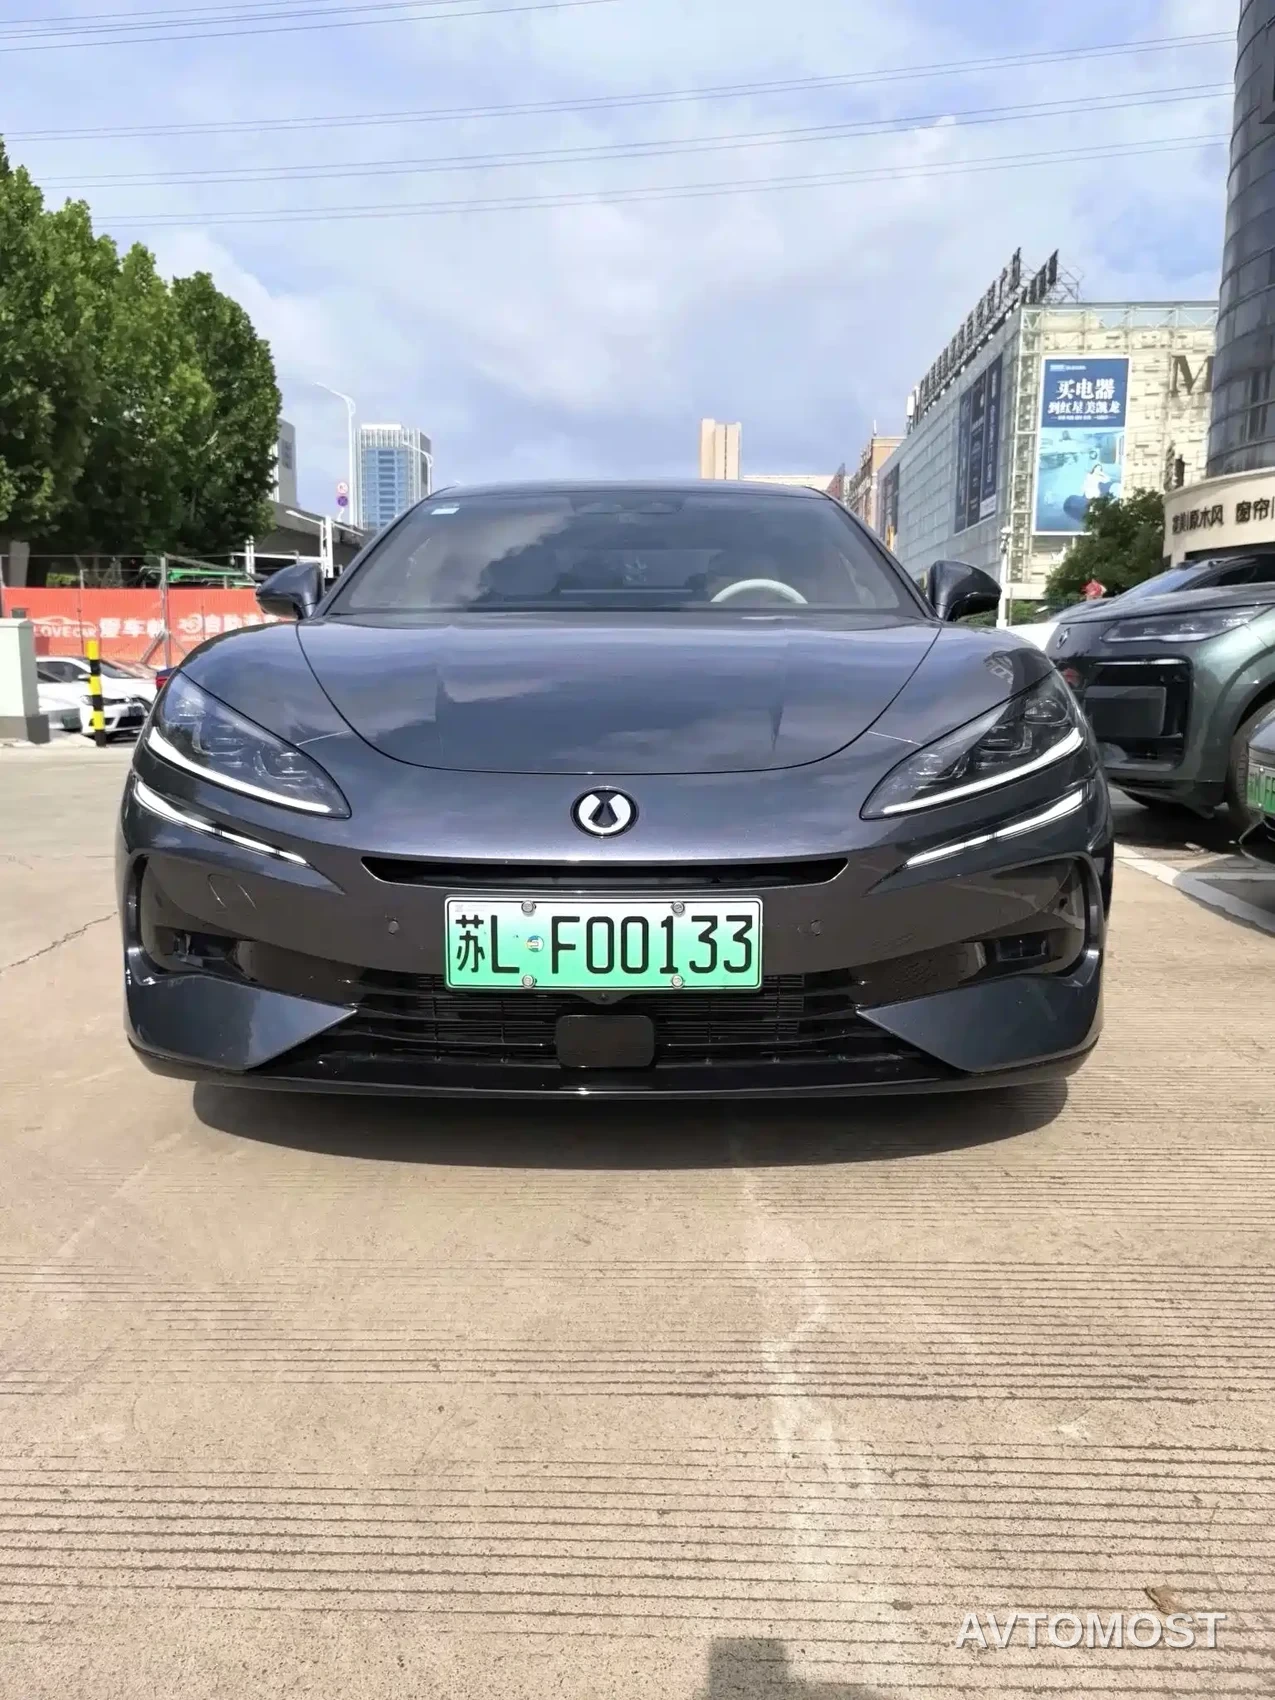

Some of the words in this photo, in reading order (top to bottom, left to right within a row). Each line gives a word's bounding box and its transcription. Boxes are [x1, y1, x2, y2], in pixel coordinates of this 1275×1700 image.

[1056, 378, 1116, 400] 买电器
[1047, 400, 1121, 414] 到红星美凯龙
[455, 914, 520, 973] 苏L
[551, 915, 753, 974] F00133
